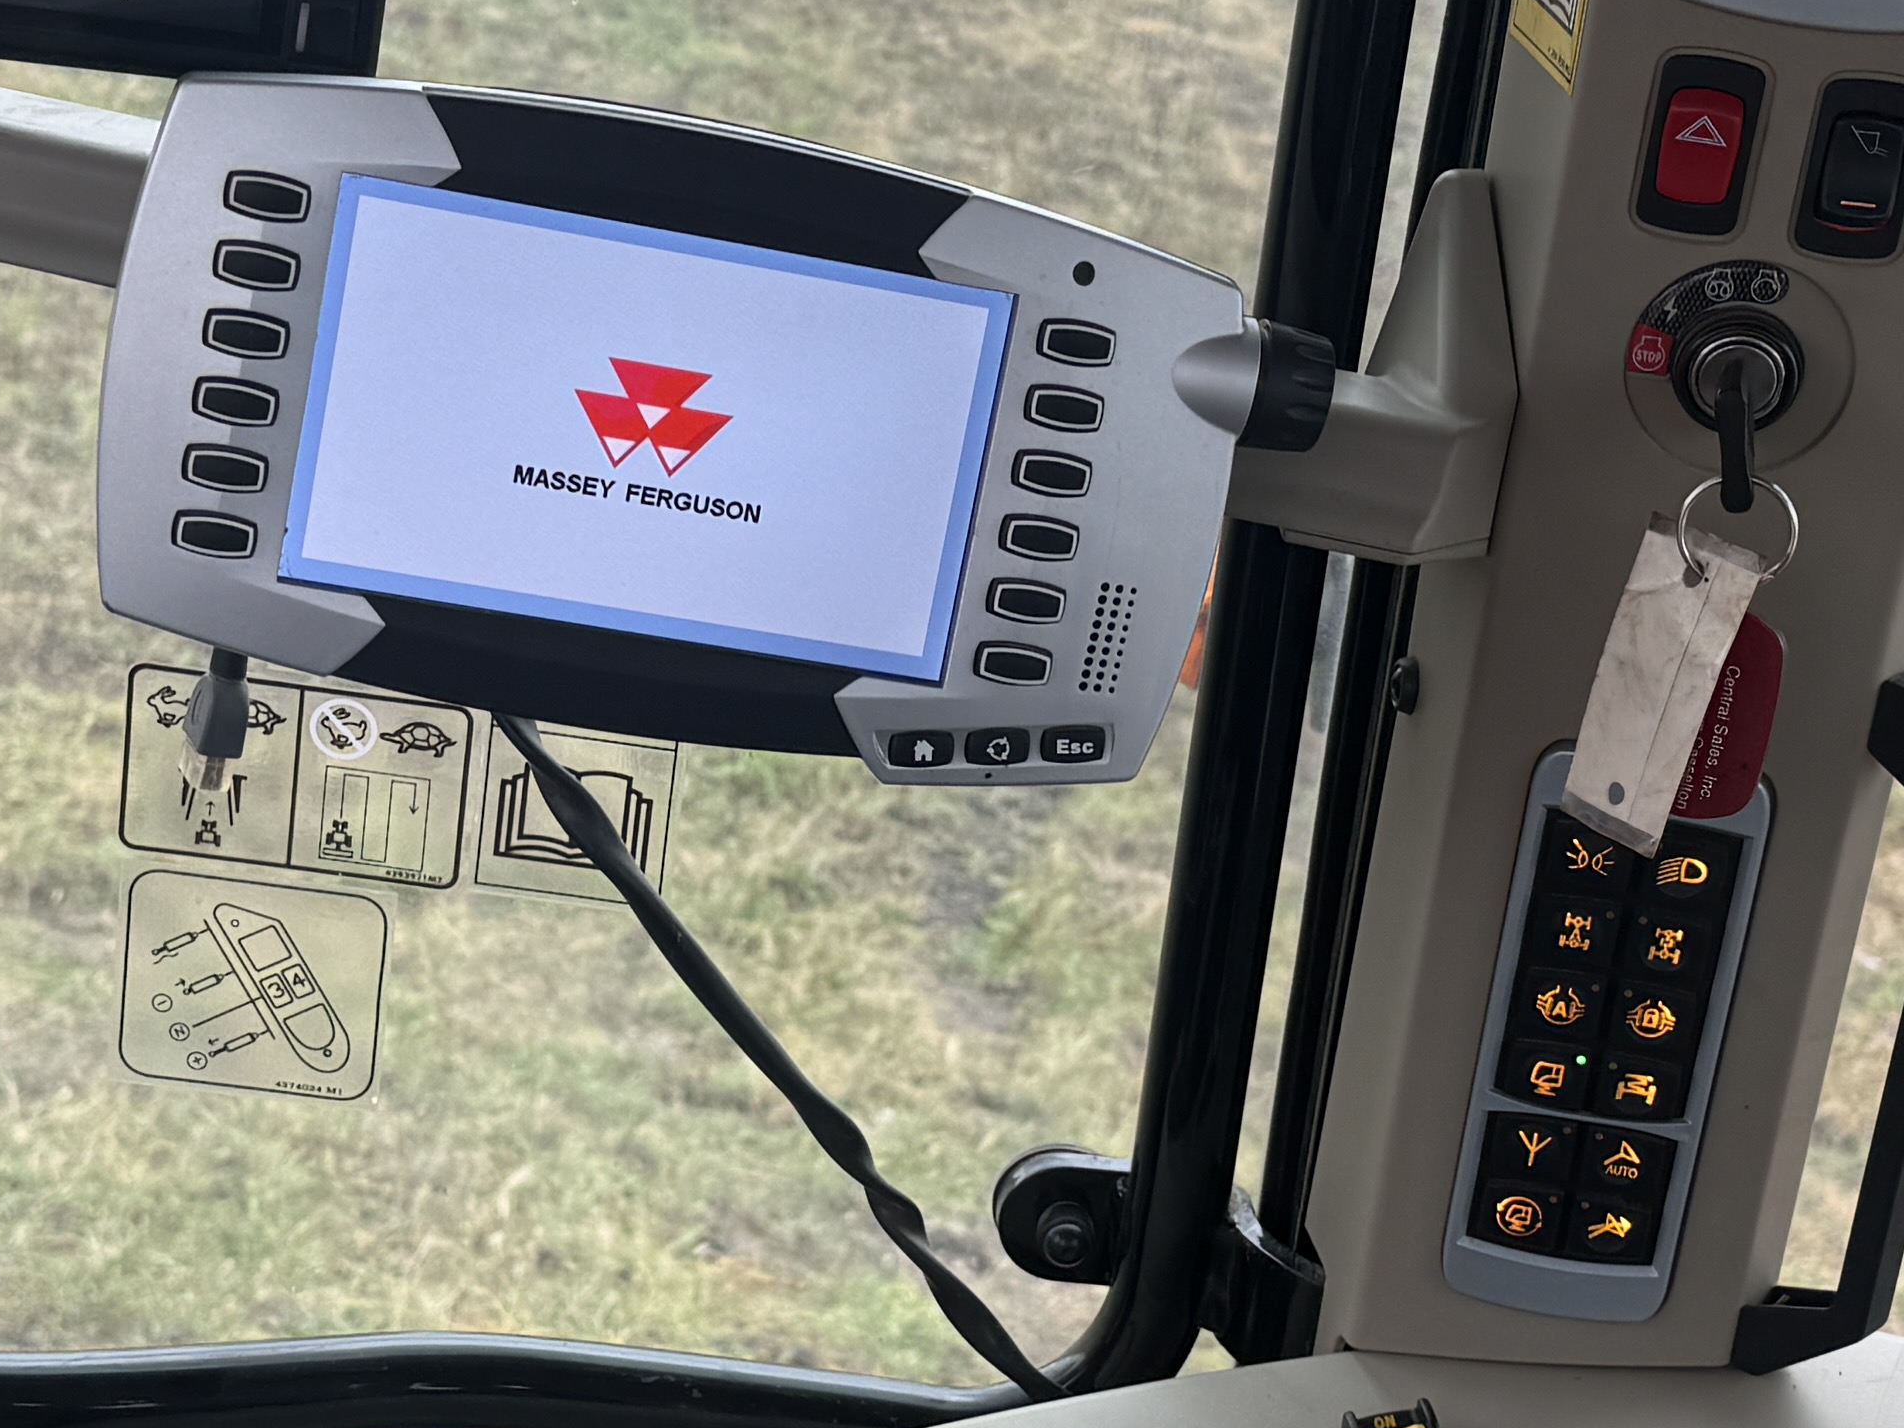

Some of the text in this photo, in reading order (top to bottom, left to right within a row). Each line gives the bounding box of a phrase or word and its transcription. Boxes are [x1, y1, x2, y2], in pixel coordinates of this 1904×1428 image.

[1636, 349, 1662, 363] STOP
[512, 464, 762, 524] MASSEY FERGUSON
[1698, 665, 1741, 801] Central Sales, Inc.
[1055, 738, 1095, 756] Esc
[292, 972, 307, 988] 4
[267, 981, 285, 999] 3
[1551, 1000, 1568, 1019] A
[1604, 1164, 1639, 1180] AUTO
